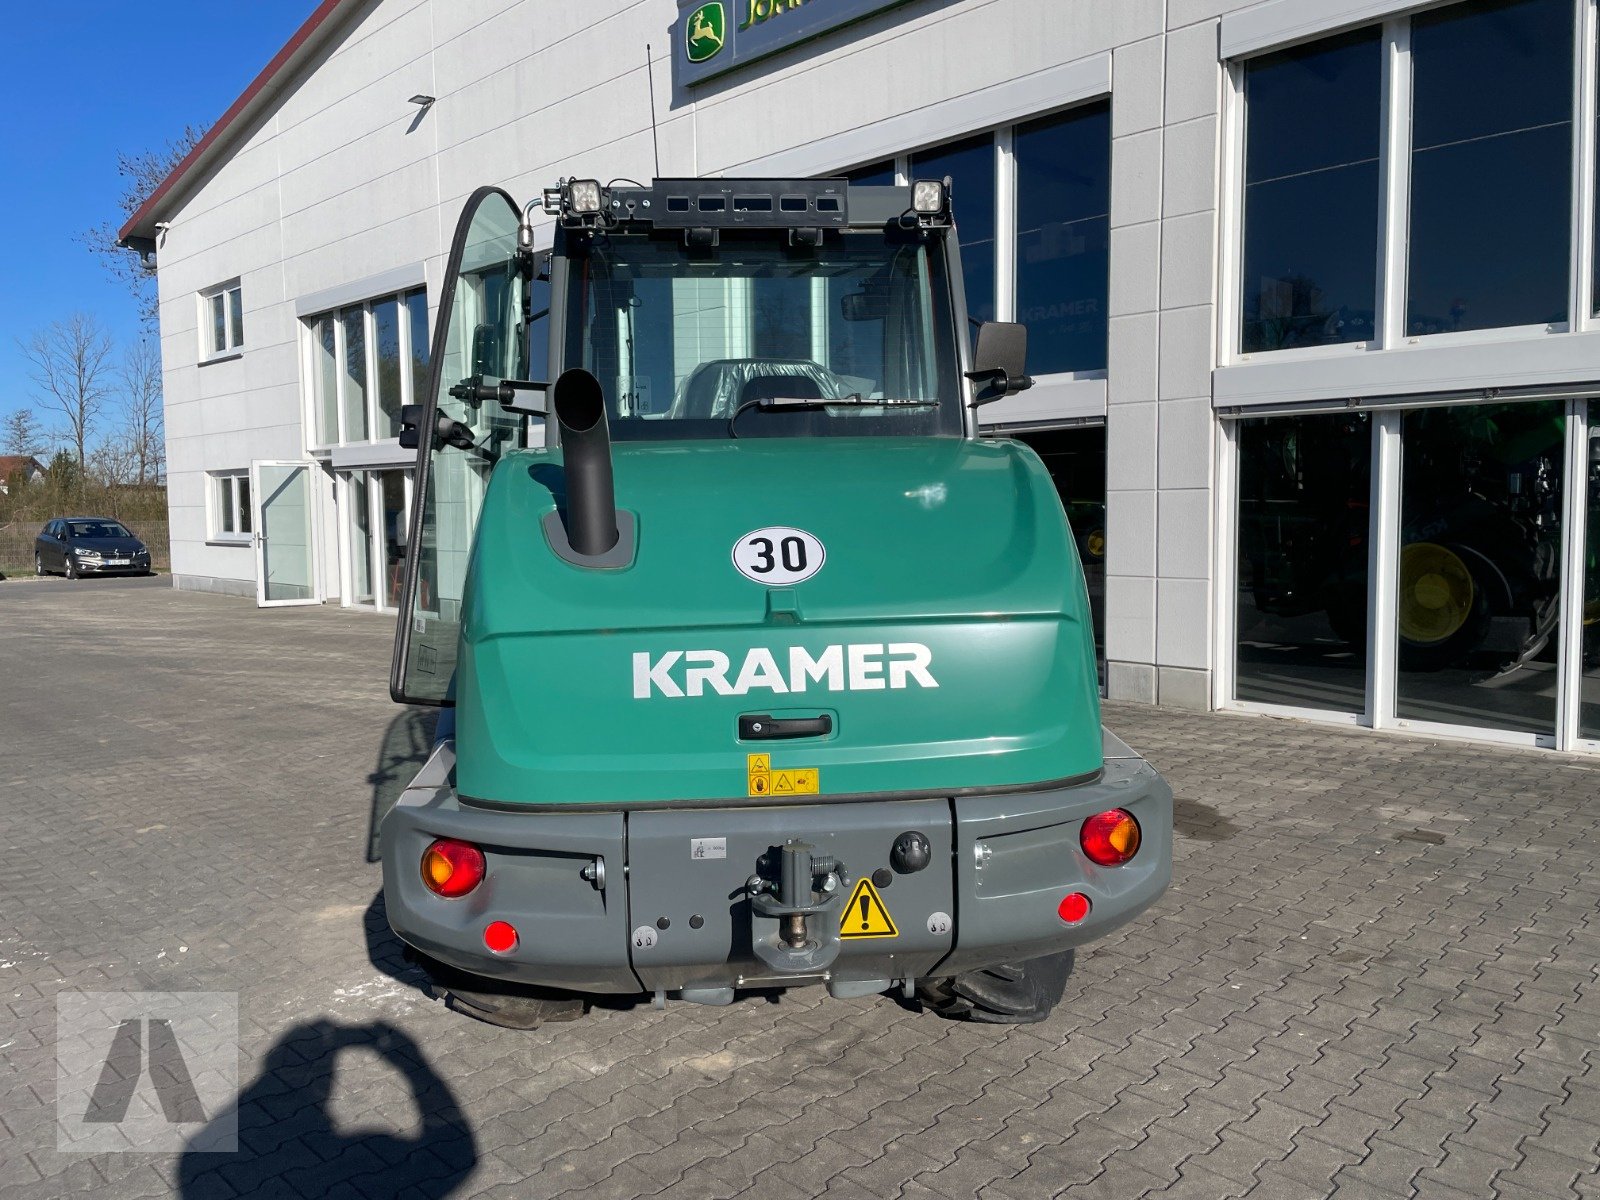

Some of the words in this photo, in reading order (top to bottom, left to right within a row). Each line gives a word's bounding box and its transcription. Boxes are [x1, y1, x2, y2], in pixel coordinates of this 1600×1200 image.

[1022, 298, 1098, 321] KRAMER
[622, 392, 640, 410] 101
[749, 536, 808, 574] 30
[633, 643, 940, 699] KRAMER
